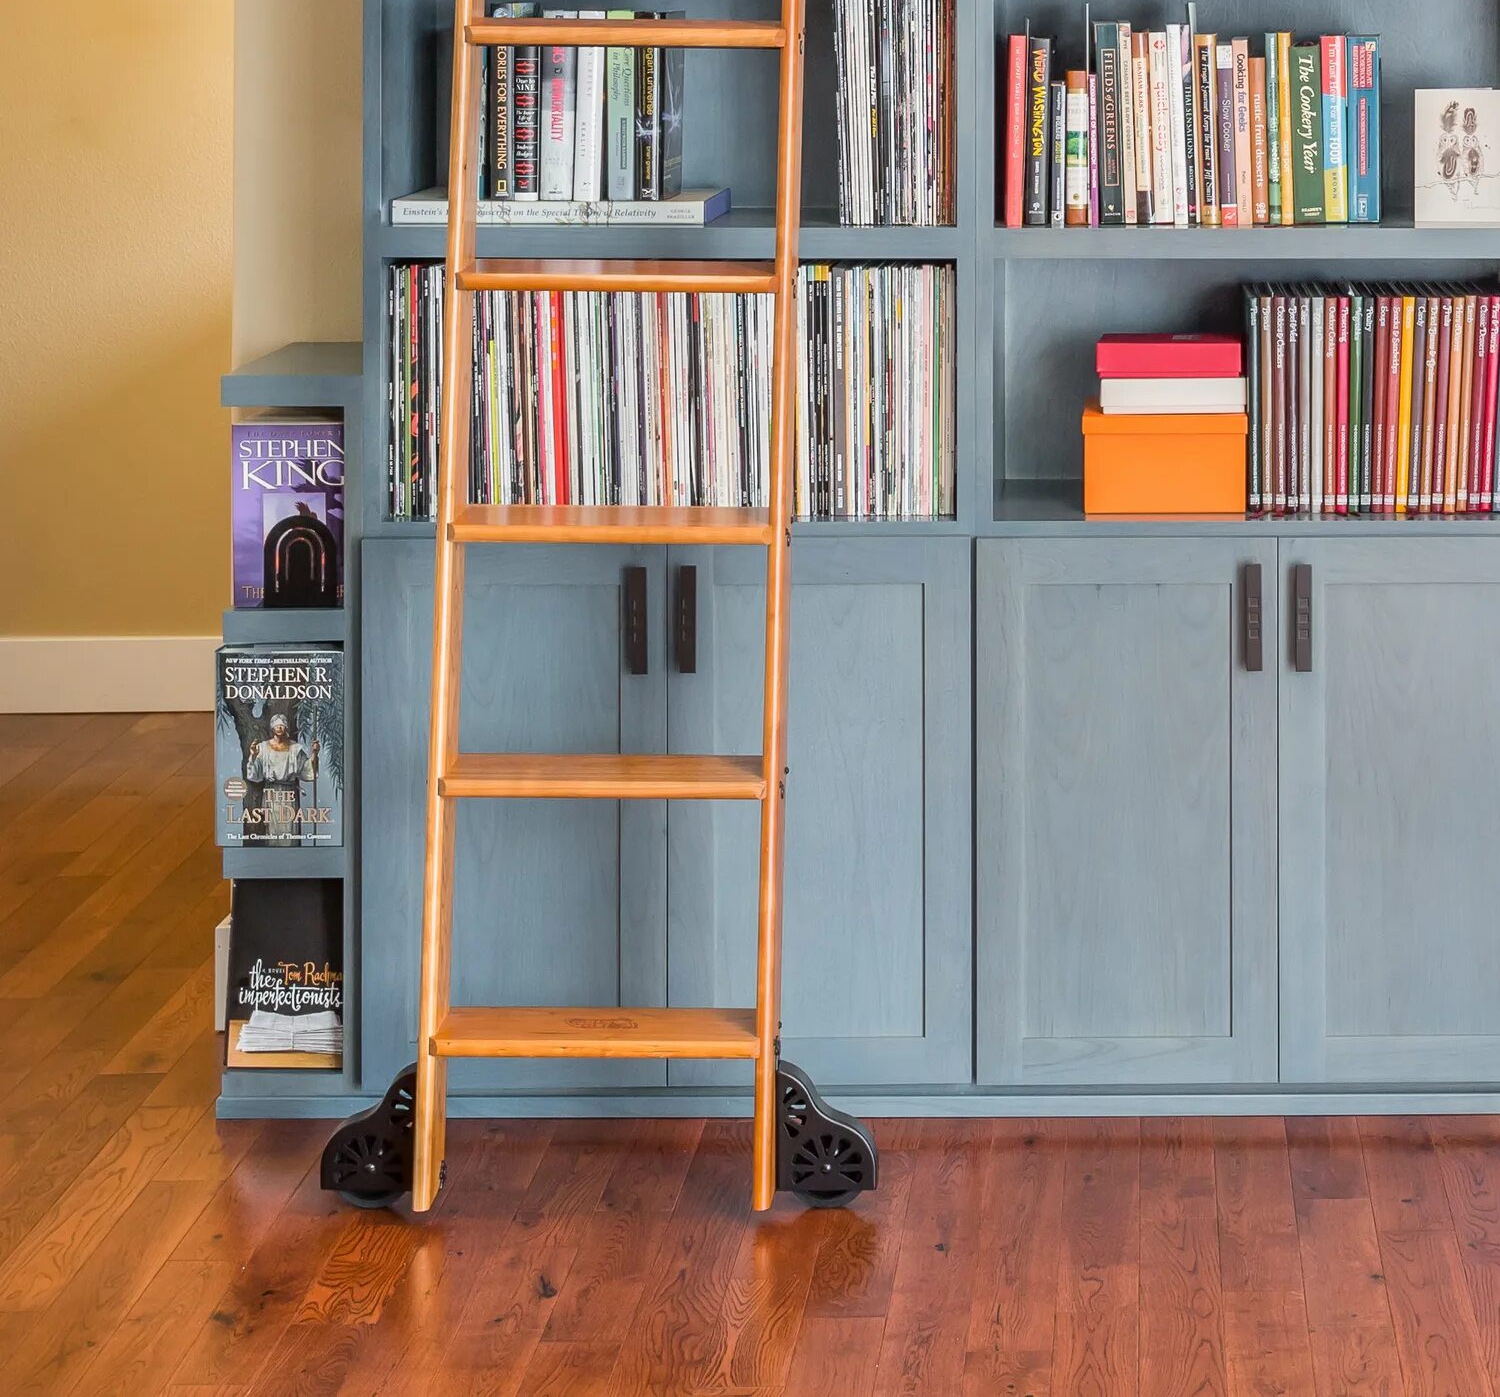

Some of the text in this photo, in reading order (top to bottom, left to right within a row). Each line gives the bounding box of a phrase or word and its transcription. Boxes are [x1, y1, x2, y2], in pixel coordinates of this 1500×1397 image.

[1104, 52, 1116, 150] FIELDS of GREENS
[1235, 53, 1247, 133] Cooking for Geeks
[497, 82, 506, 169] FOR EVERYTHING
[1032, 86, 1046, 156] WASHINGTON
[1223, 99, 1231, 152] Slow Cooker
[1297, 55, 1317, 173] The Cookery Year
[1254, 94, 1265, 187] rustic fruit desserts
[403, 207, 443, 218] Einstein's
[1339, 307, 1348, 343] Preserving
[1365, 307, 1373, 332] Poultry
[1416, 306, 1425, 327] Candy
[1478, 305, 1487, 357] Classic Desserts
[239, 439, 344, 458] STEPHEN
[242, 460, 344, 490] KING
[225, 667, 332, 683] STEPHEN R.
[225, 685, 332, 700] DONALDSON
[263, 788, 295, 803] THE
[226, 805, 334, 824] LAST DARK
[249, 958, 343, 989] the Tom Rachma
[239, 979, 344, 1012] imperfectionists
